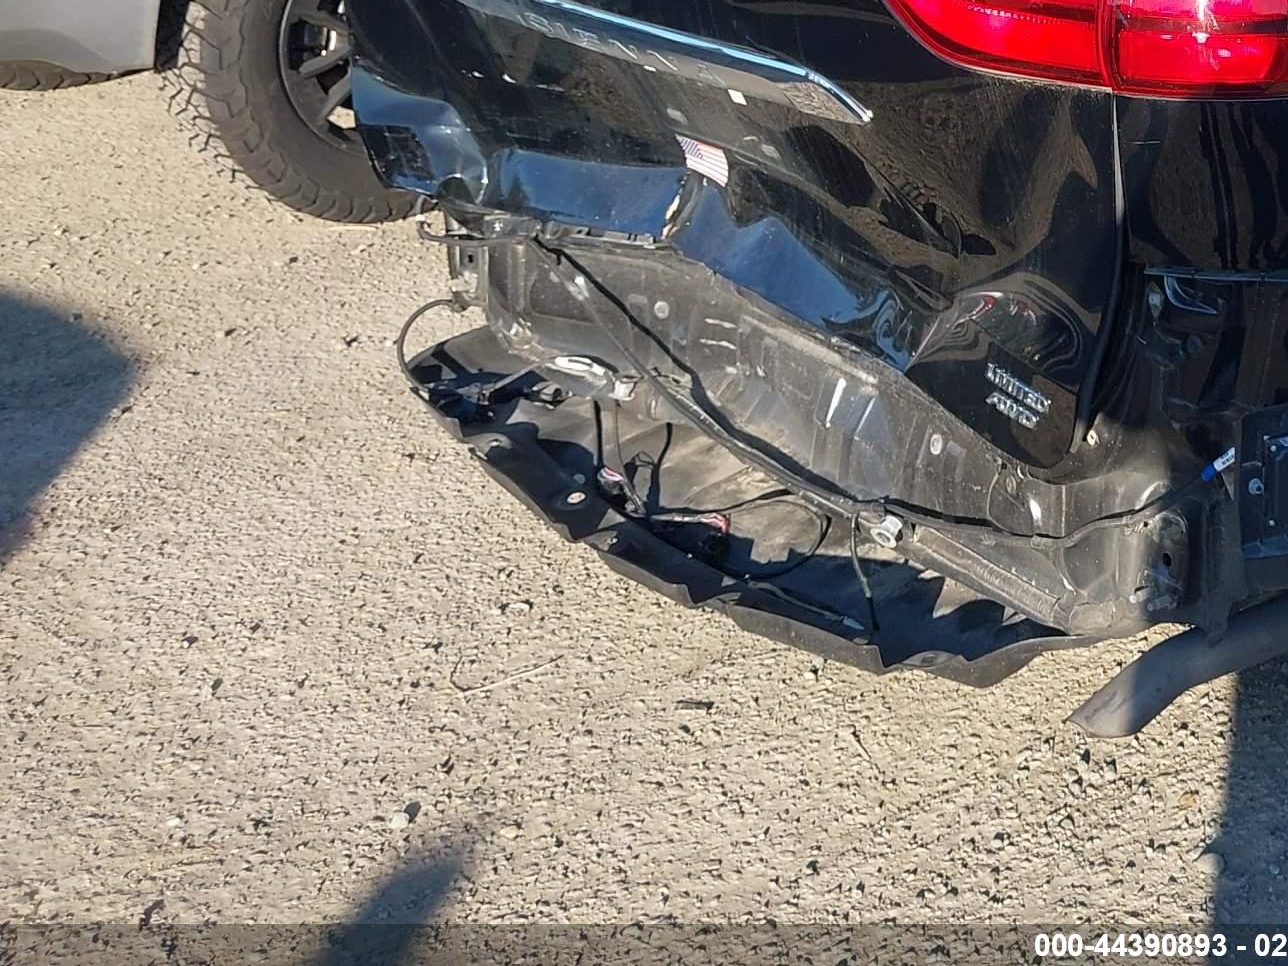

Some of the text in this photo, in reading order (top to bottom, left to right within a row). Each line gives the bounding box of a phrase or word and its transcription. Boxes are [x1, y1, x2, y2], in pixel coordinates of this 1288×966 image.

[517, 10, 728, 88] SIENNA
[985, 362, 1051, 413] LIMITED
[985, 392, 1040, 428] AWD
